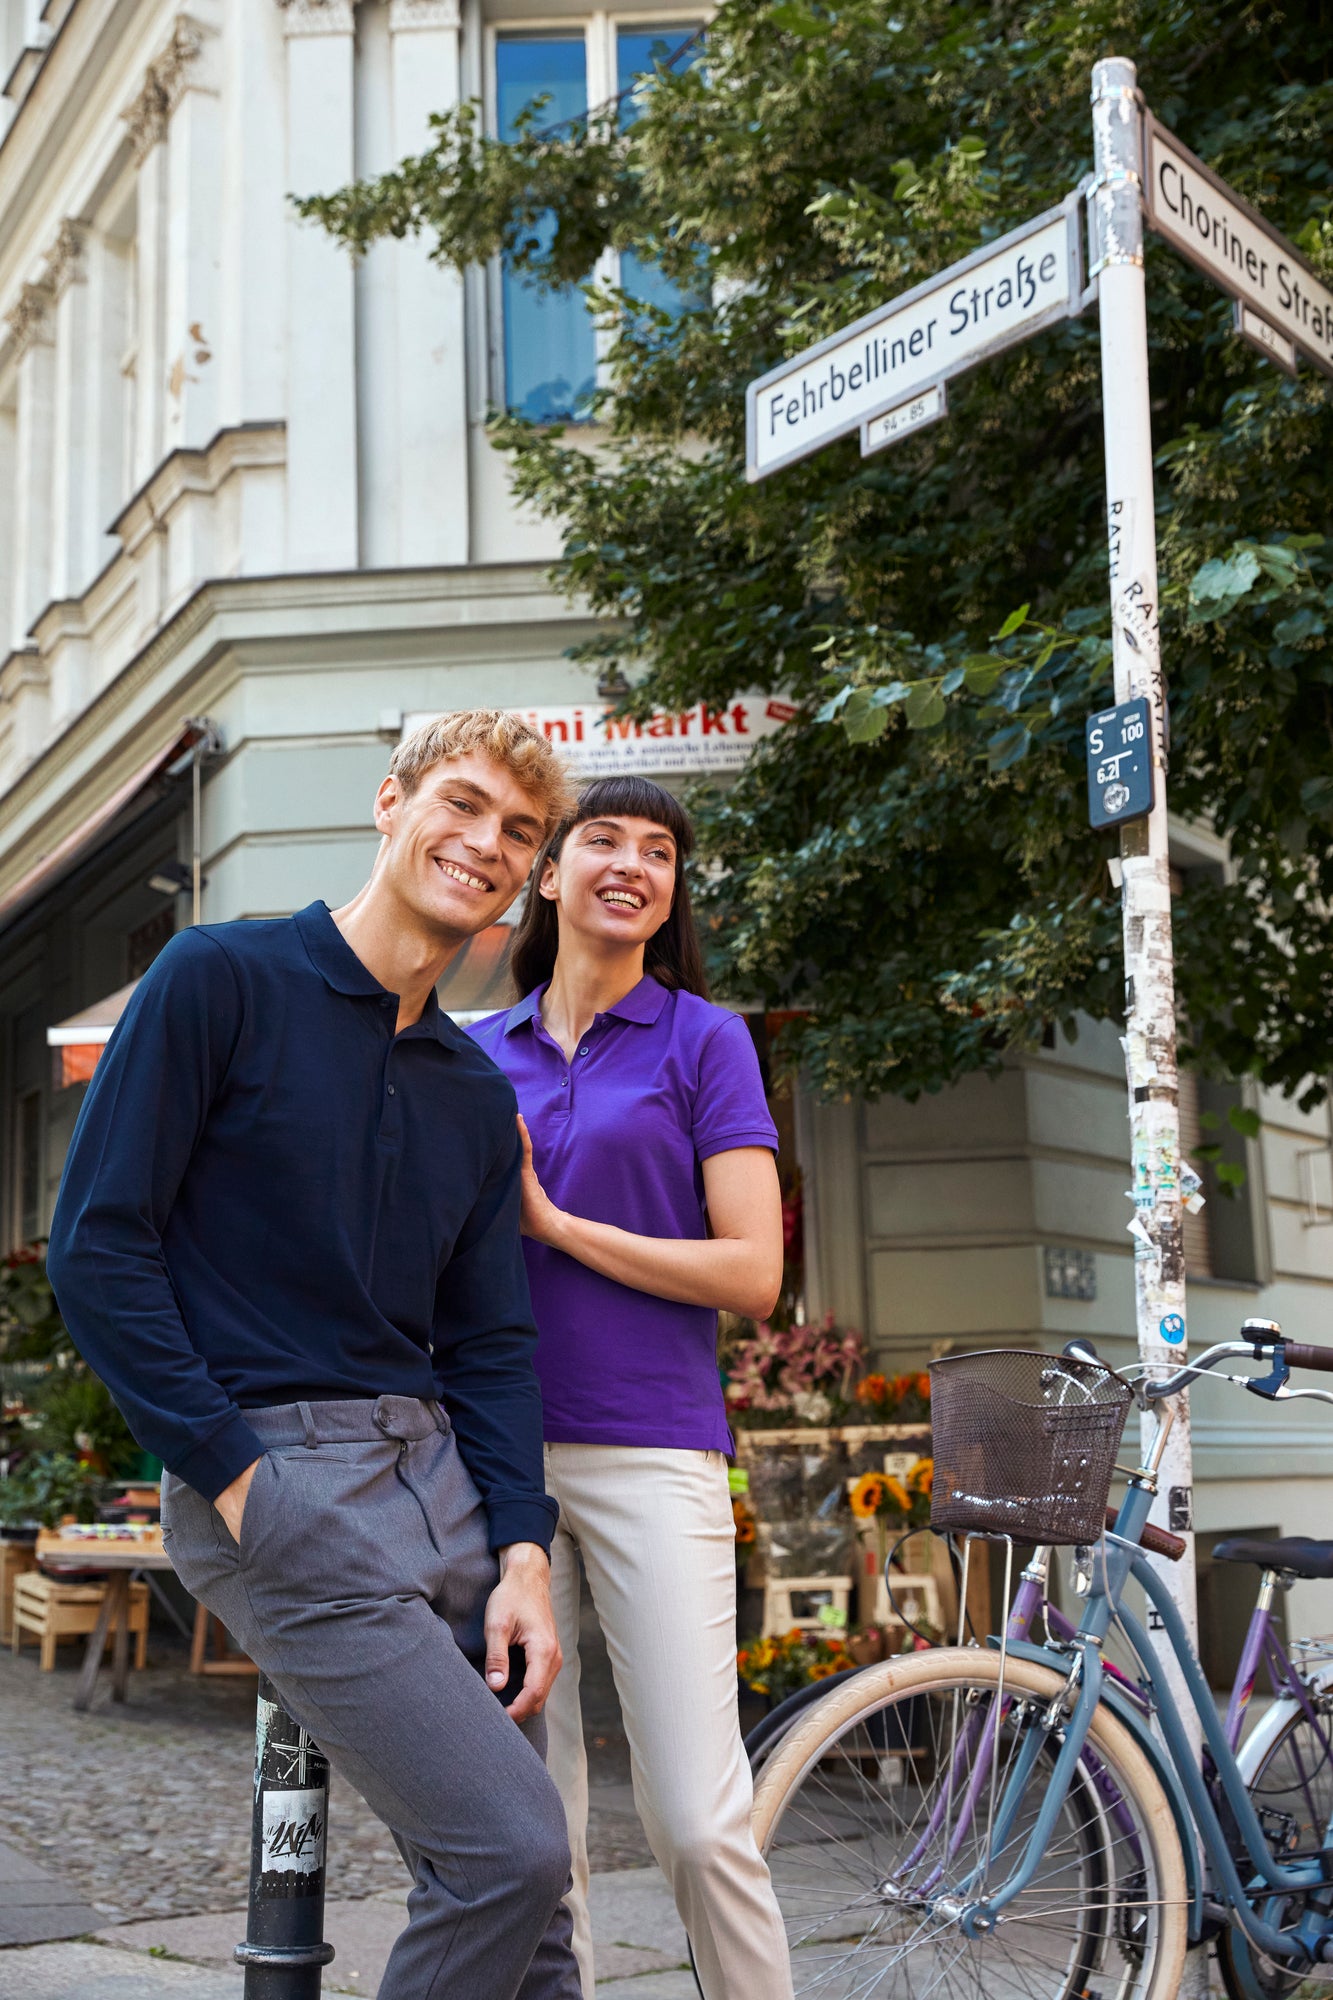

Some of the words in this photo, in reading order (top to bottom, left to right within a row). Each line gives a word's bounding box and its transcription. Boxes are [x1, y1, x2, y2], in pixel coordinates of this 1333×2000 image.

[1159, 160, 1268, 289] Choriner
[769, 319, 937, 436] Fehrbelliner
[949, 252, 1057, 336] Straße
[604, 702, 749, 741] Markt
[1089, 728, 1104, 755] S
[1121, 721, 1144, 744] 100
